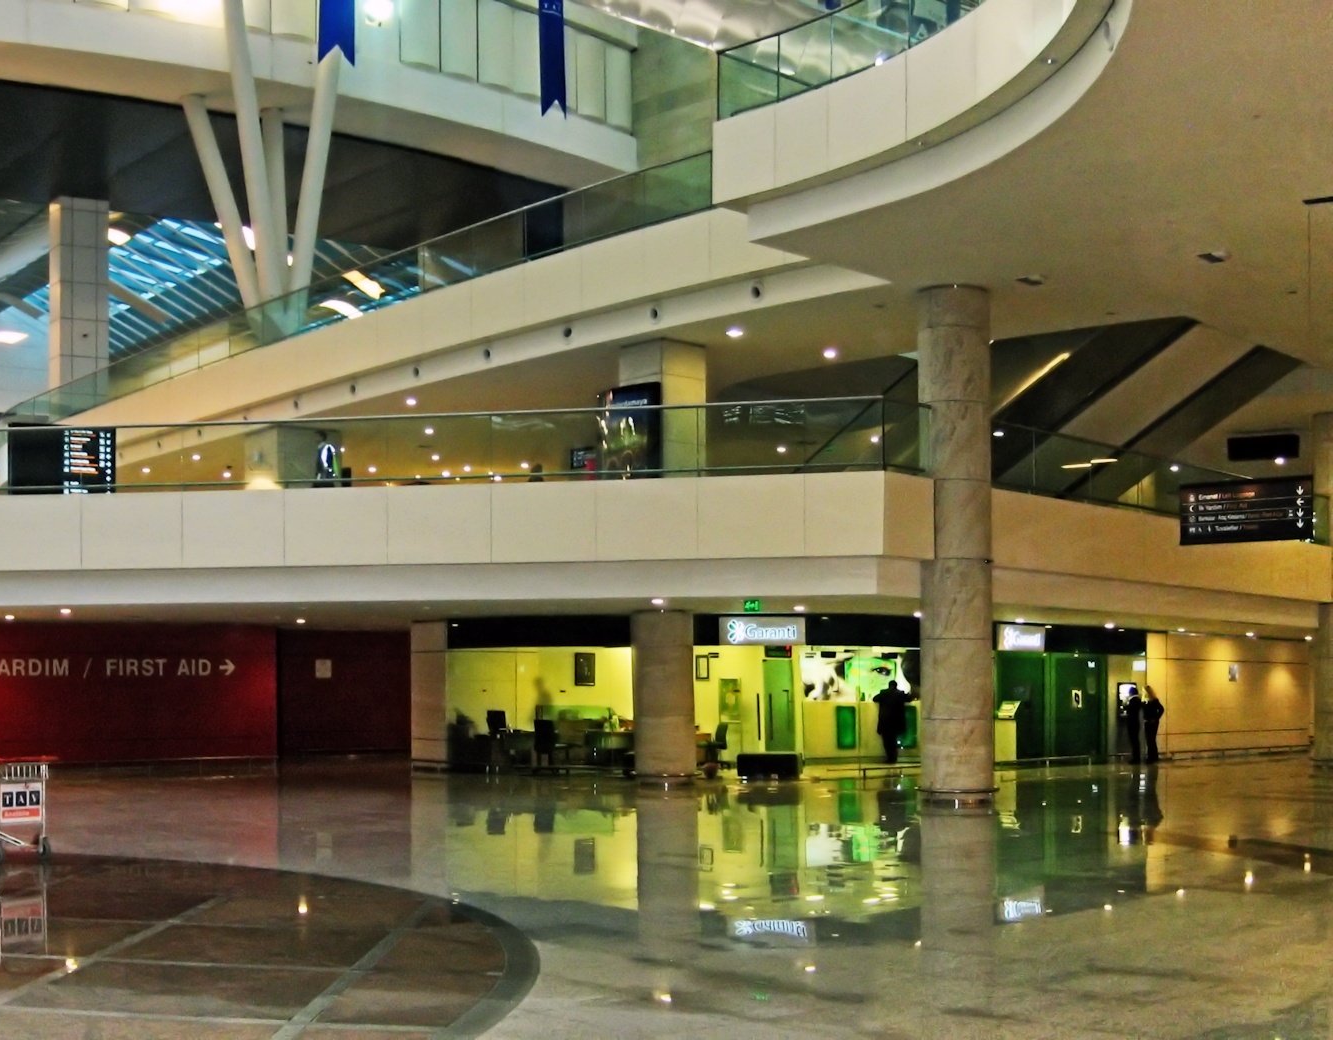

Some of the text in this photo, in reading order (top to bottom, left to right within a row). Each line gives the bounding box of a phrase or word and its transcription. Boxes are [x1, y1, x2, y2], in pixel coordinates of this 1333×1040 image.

[745, 624, 797, 640] Garanti
[83, 657, 93, 679] /
[106, 658, 167, 677] FIRST
[177, 658, 212, 677] AID
[3, 793, 39, 805] TAV
